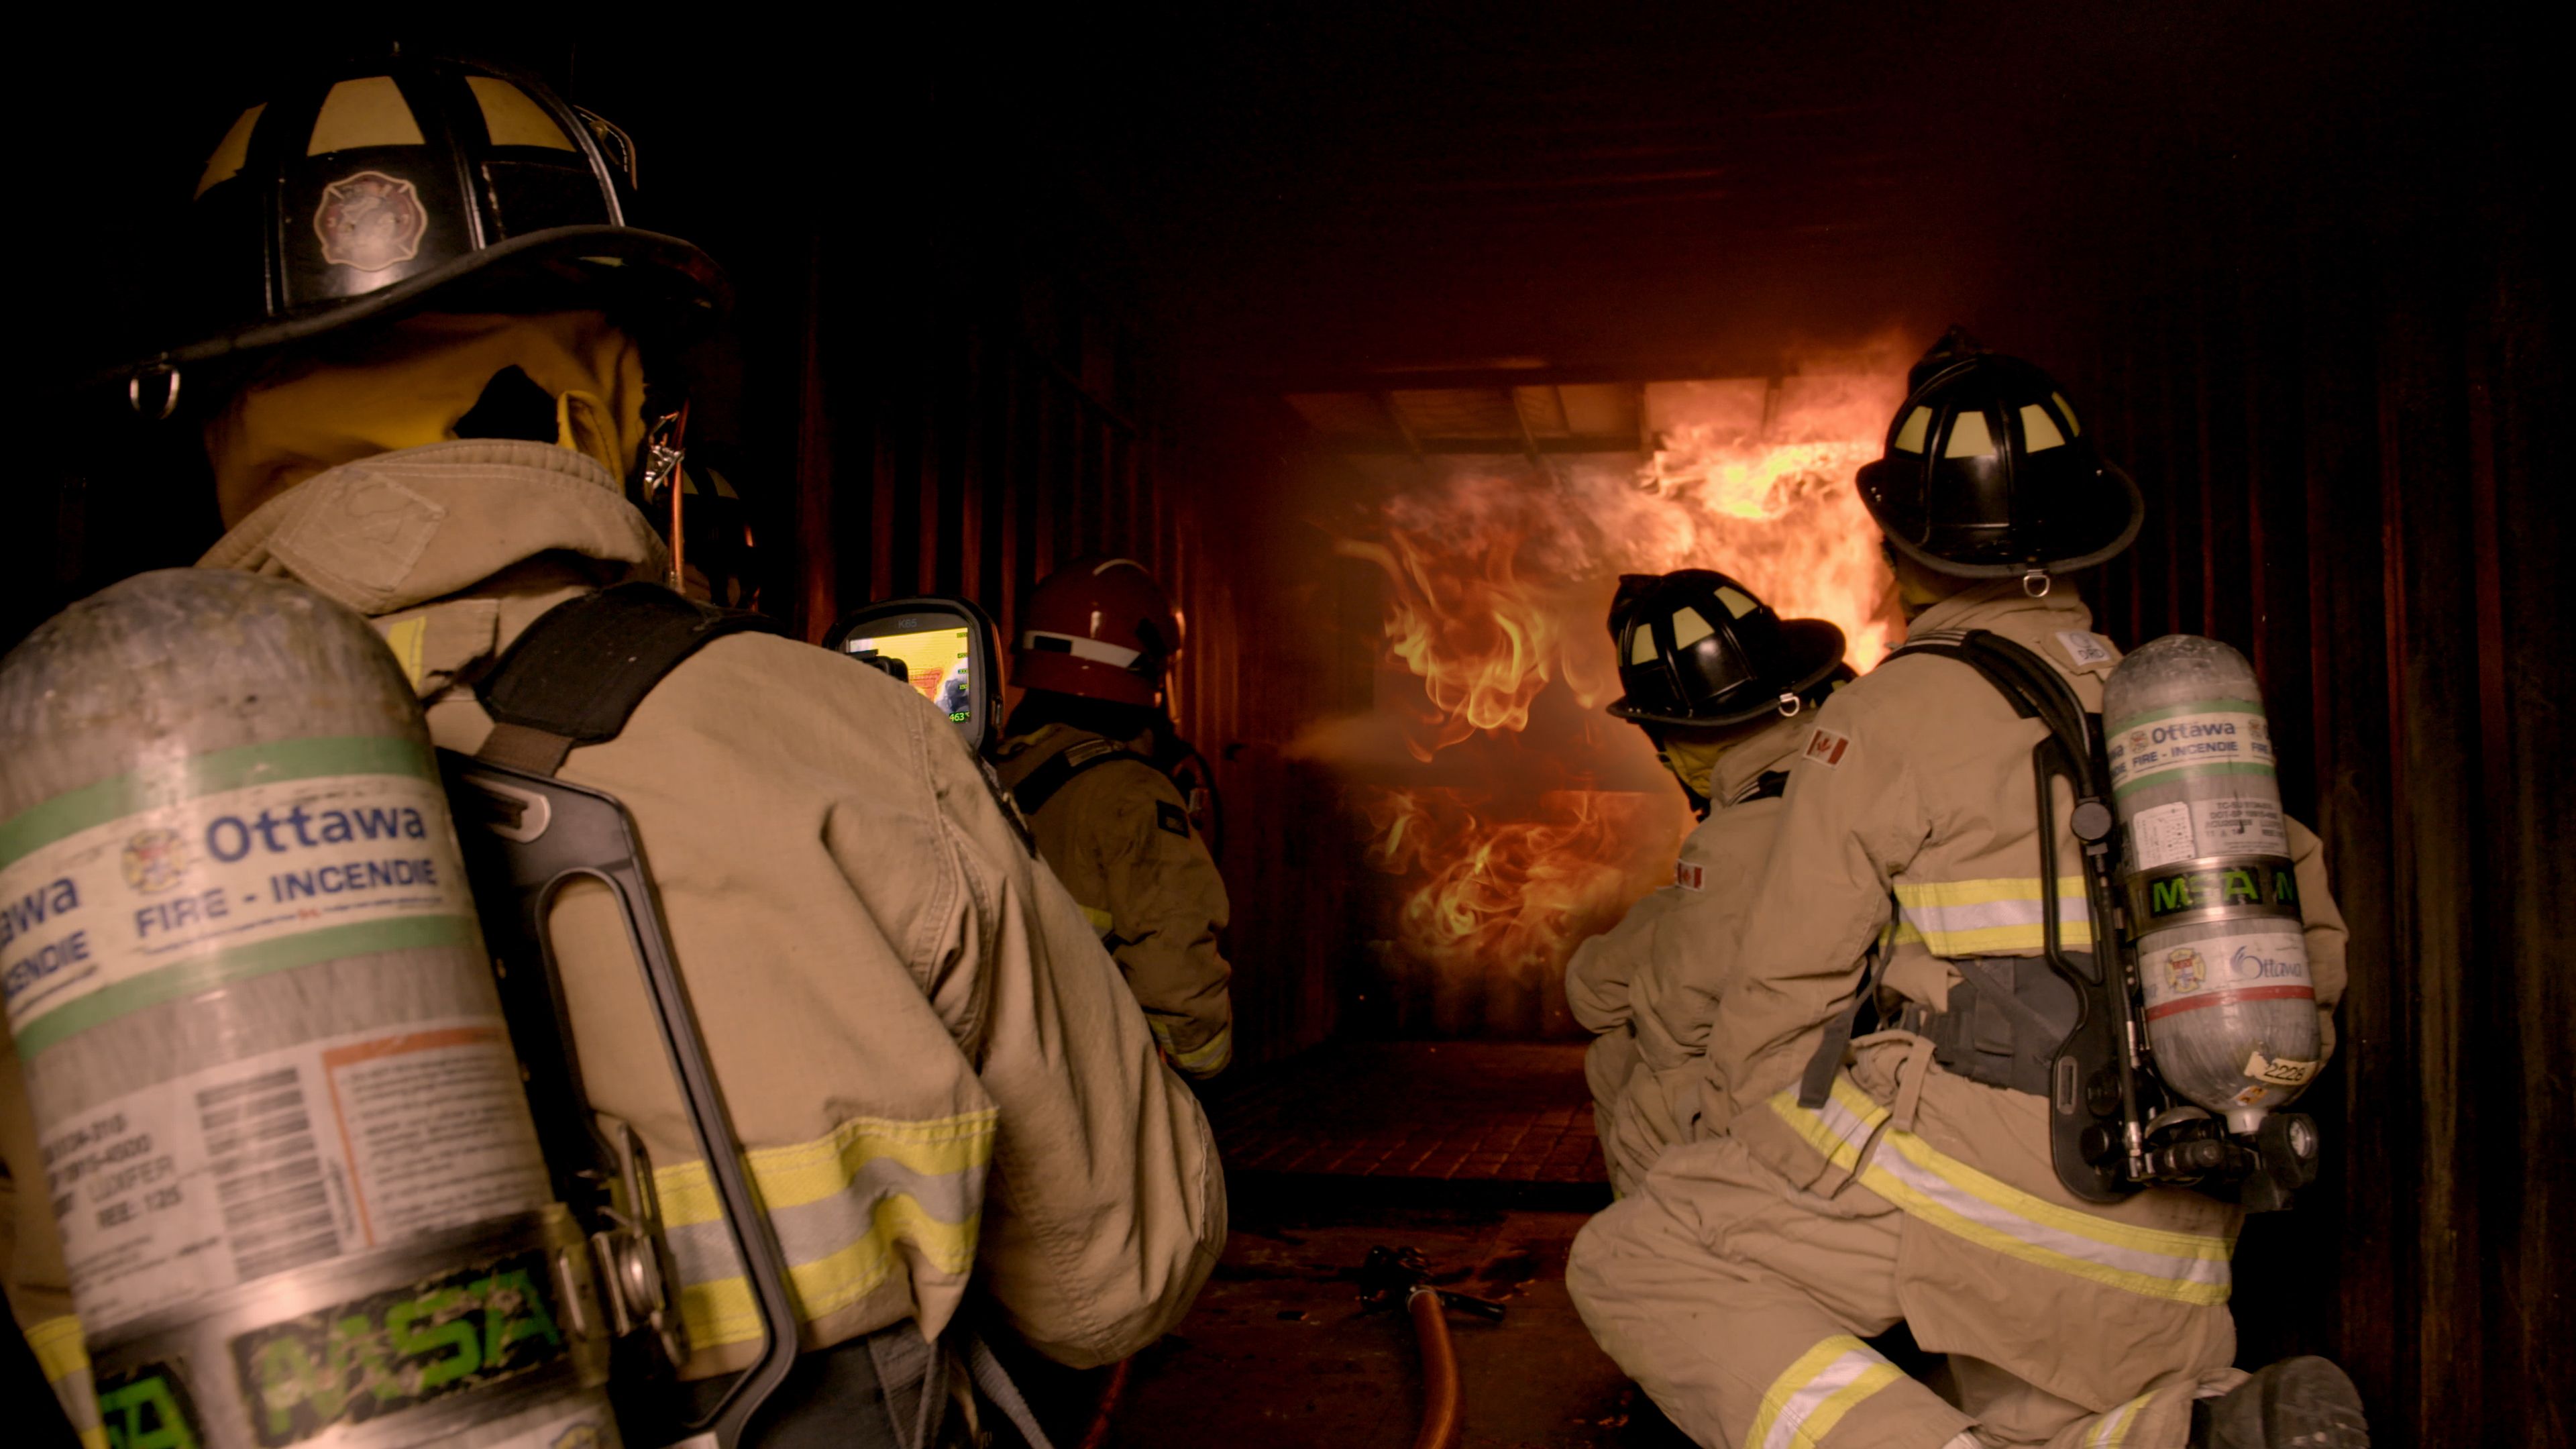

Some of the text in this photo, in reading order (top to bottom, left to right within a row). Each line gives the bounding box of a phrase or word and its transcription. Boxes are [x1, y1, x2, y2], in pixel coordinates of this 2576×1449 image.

[949, 713, 964, 721] 463
[2151, 722, 2236, 745] Ottawa
[2132, 751, 2158, 767] FIRE
[2171, 741, 2238, 757] INCENDIE
[205, 805, 427, 863] Ottawa
[136, 889, 229, 938] FIRE
[270, 859, 437, 902] INCENDIE
[2153, 871, 2259, 912] MSA
[2230, 945, 2302, 979] Ottawa
[260, 1267, 559, 1434] MSA
